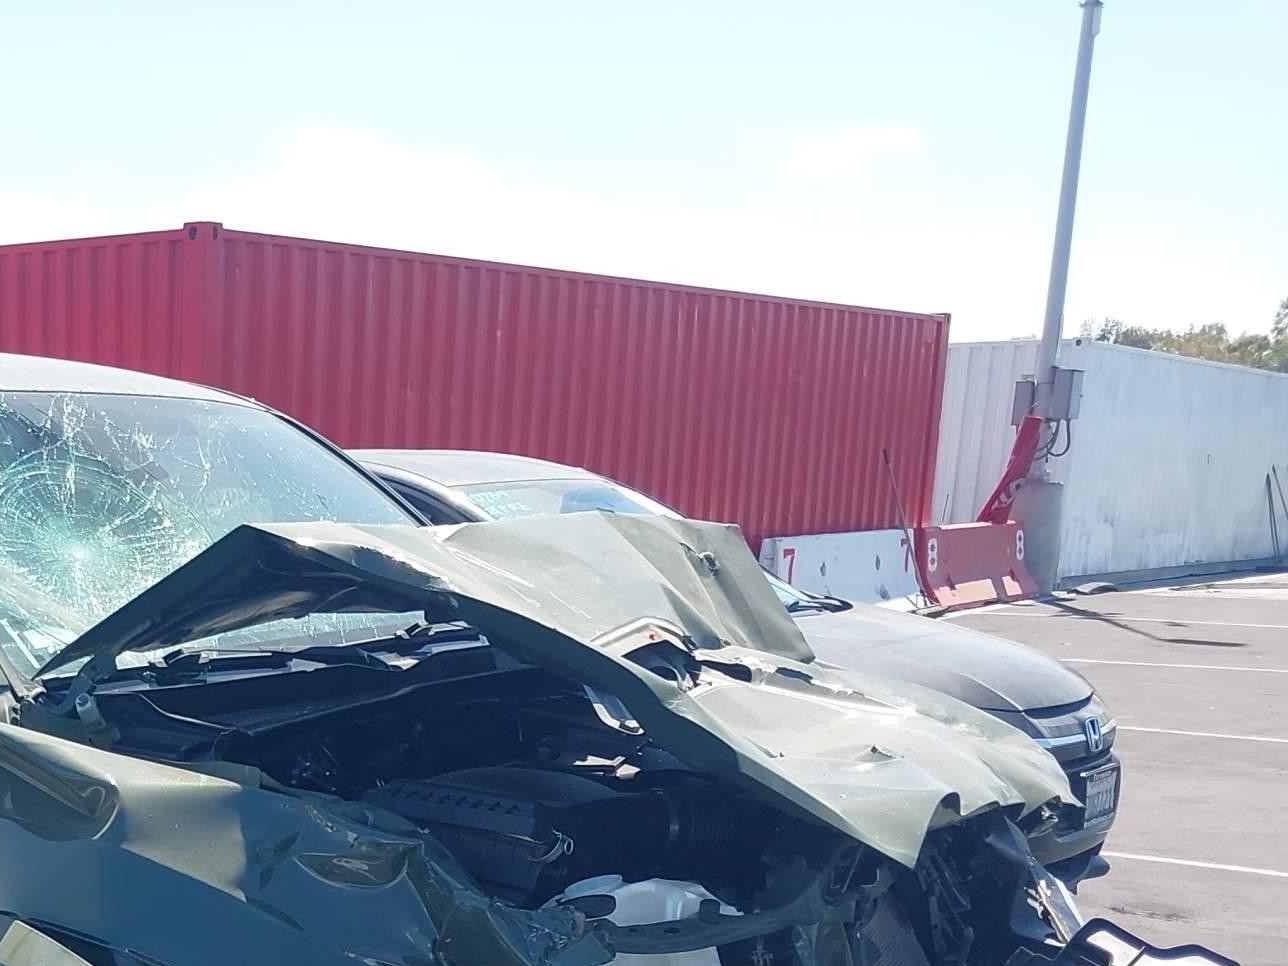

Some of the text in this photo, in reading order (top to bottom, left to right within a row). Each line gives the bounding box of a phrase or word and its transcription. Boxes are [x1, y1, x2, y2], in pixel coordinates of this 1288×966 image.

[927, 537, 938, 572] 8
[1015, 529, 1025, 561] 8
[782, 548, 796, 585] 7
